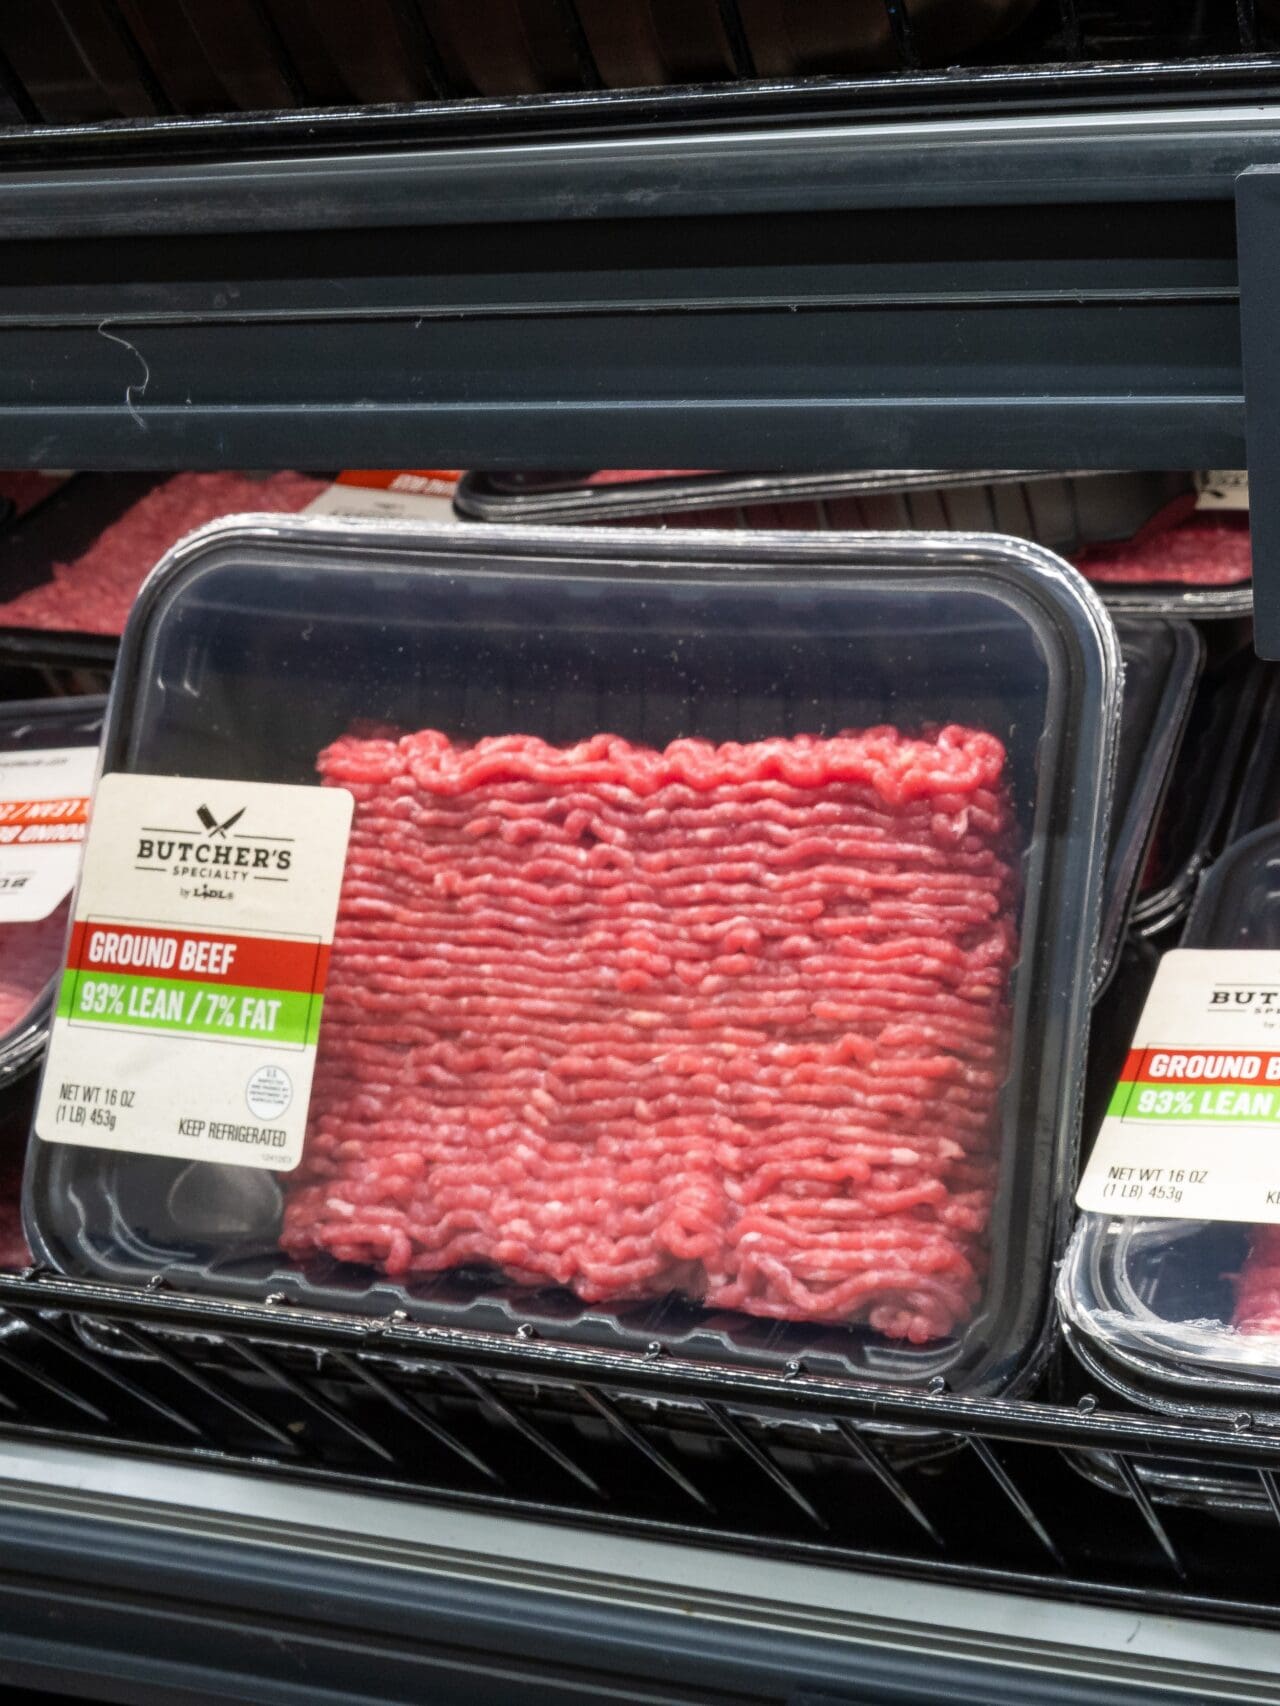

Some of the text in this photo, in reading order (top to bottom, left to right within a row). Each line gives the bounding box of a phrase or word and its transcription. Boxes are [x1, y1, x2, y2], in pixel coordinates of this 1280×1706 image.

[136, 839, 292, 870] BUTCHER'S
[172, 866, 250, 881] SPECIALTY
[88, 931, 237, 975] GROUND BEEF
[80, 981, 281, 1032] 93% LEAN / 7% FAT
[1148, 1054, 1262, 1080] GROUND
[60, 1083, 135, 1108] NET WT 16 OZ
[1137, 1090, 1194, 1116] 93%
[1200, 1092, 1274, 1118] LEAN
[55, 1106, 116, 1132] (1 LB) 453g
[178, 1117, 286, 1148] KEEP REFRIGERATED
[1107, 1166, 1209, 1184] NET WT 16 OZ
[1102, 1184, 1183, 1202] (1 LB) 453g
